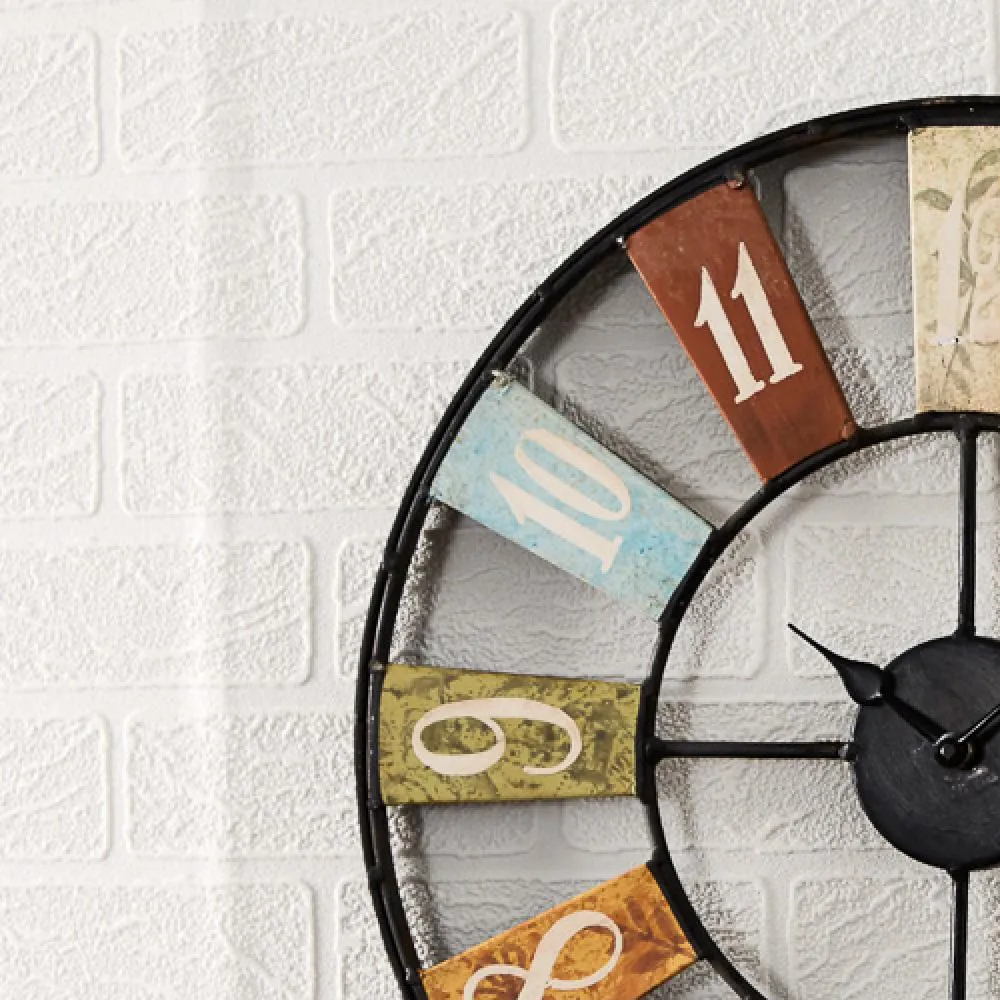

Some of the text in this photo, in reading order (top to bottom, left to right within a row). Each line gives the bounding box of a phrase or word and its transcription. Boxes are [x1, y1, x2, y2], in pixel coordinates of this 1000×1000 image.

[694, 242, 803, 404] 11
[489, 428, 631, 574] 10
[411, 697, 582, 777] 9
